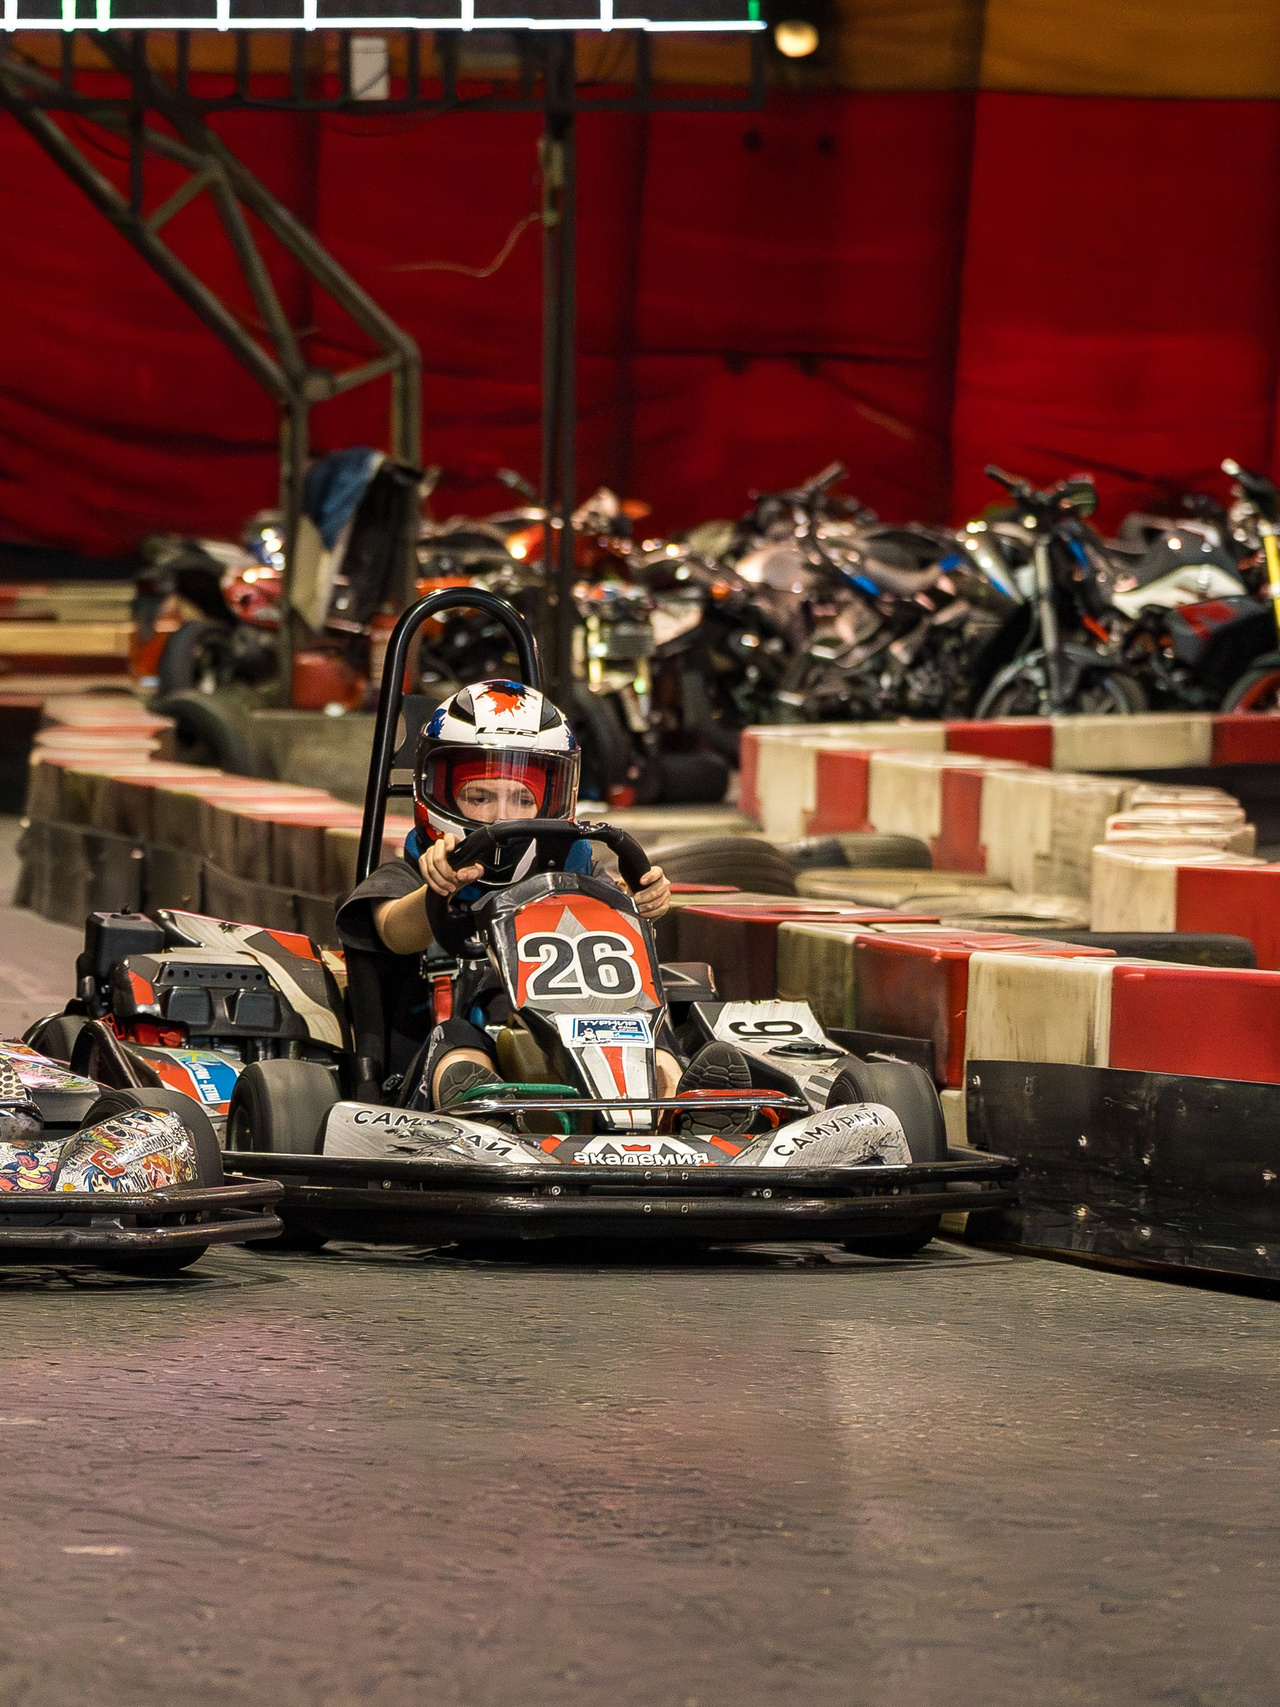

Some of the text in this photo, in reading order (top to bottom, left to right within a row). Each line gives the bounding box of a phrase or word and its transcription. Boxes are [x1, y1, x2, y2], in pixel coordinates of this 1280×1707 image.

[476, 726, 539, 738] LS2
[519, 933, 641, 998] 26
[353, 1110, 519, 1157] САМАЙ
[573, 1152, 709, 1166] академия
